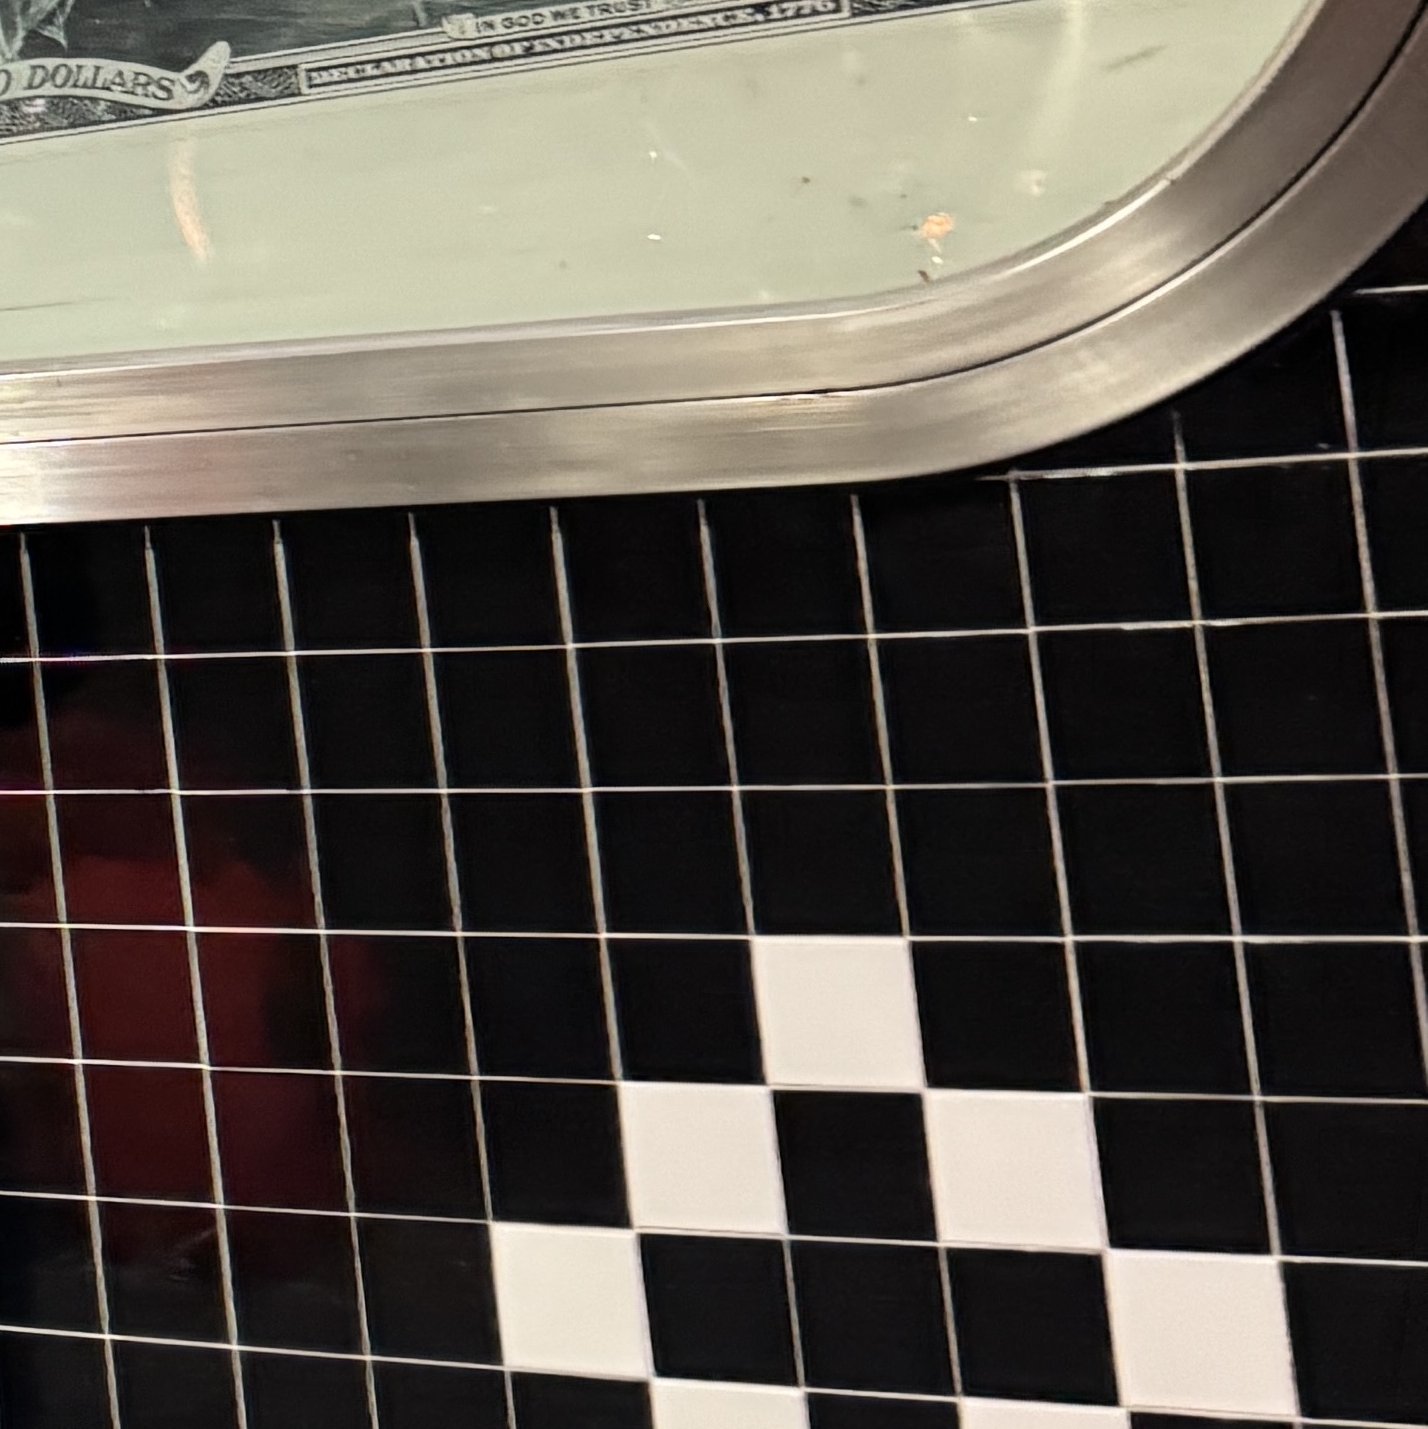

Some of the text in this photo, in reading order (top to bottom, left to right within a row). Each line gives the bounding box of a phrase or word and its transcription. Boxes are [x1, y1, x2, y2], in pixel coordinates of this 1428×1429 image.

[501, 11, 547, 29] GOD
[549, 6, 582, 23] WE
[24, 61, 179, 103] DOLLARS
